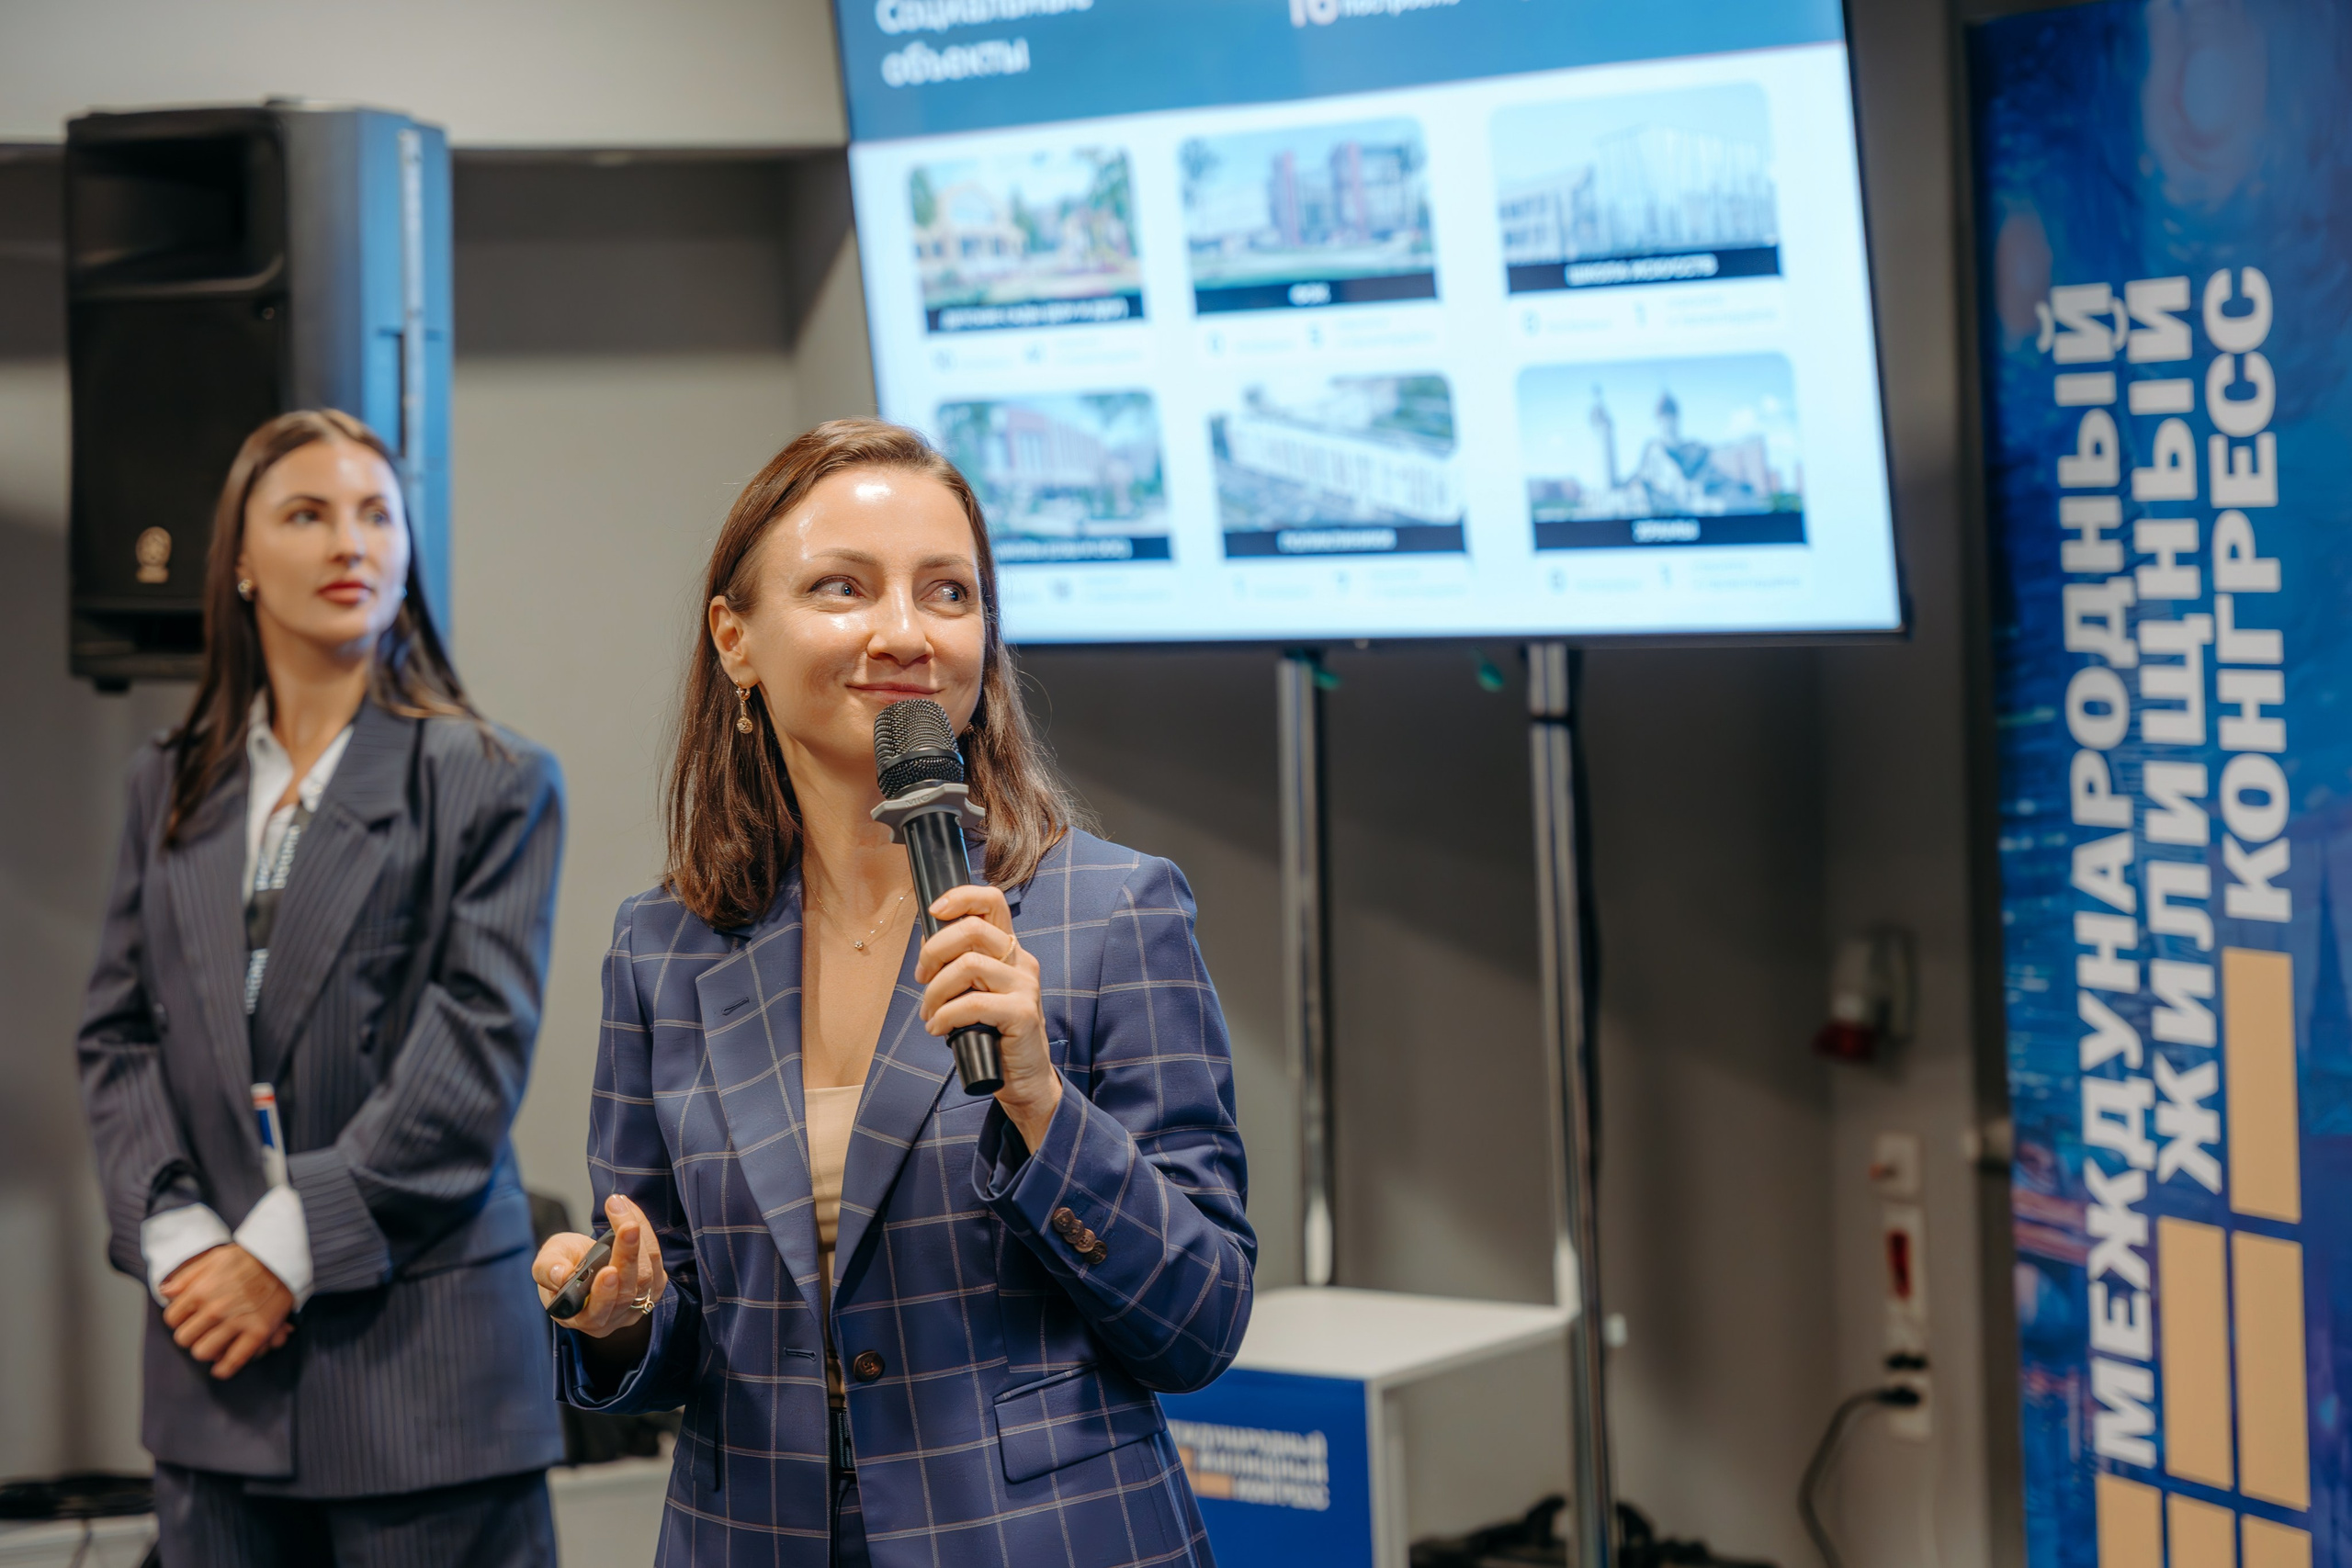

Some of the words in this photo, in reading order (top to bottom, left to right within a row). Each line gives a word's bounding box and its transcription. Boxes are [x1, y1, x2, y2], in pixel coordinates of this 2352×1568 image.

[876, 0, 1094, 34] Социальн
[2035, 282, 2157, 1470] МЕЖДУНАРОДНЫЙ
[2115, 276, 2222, 1196] ЖИЛИЩНЫЙ
[2202, 265, 2293, 923] КОНГРЕСС
